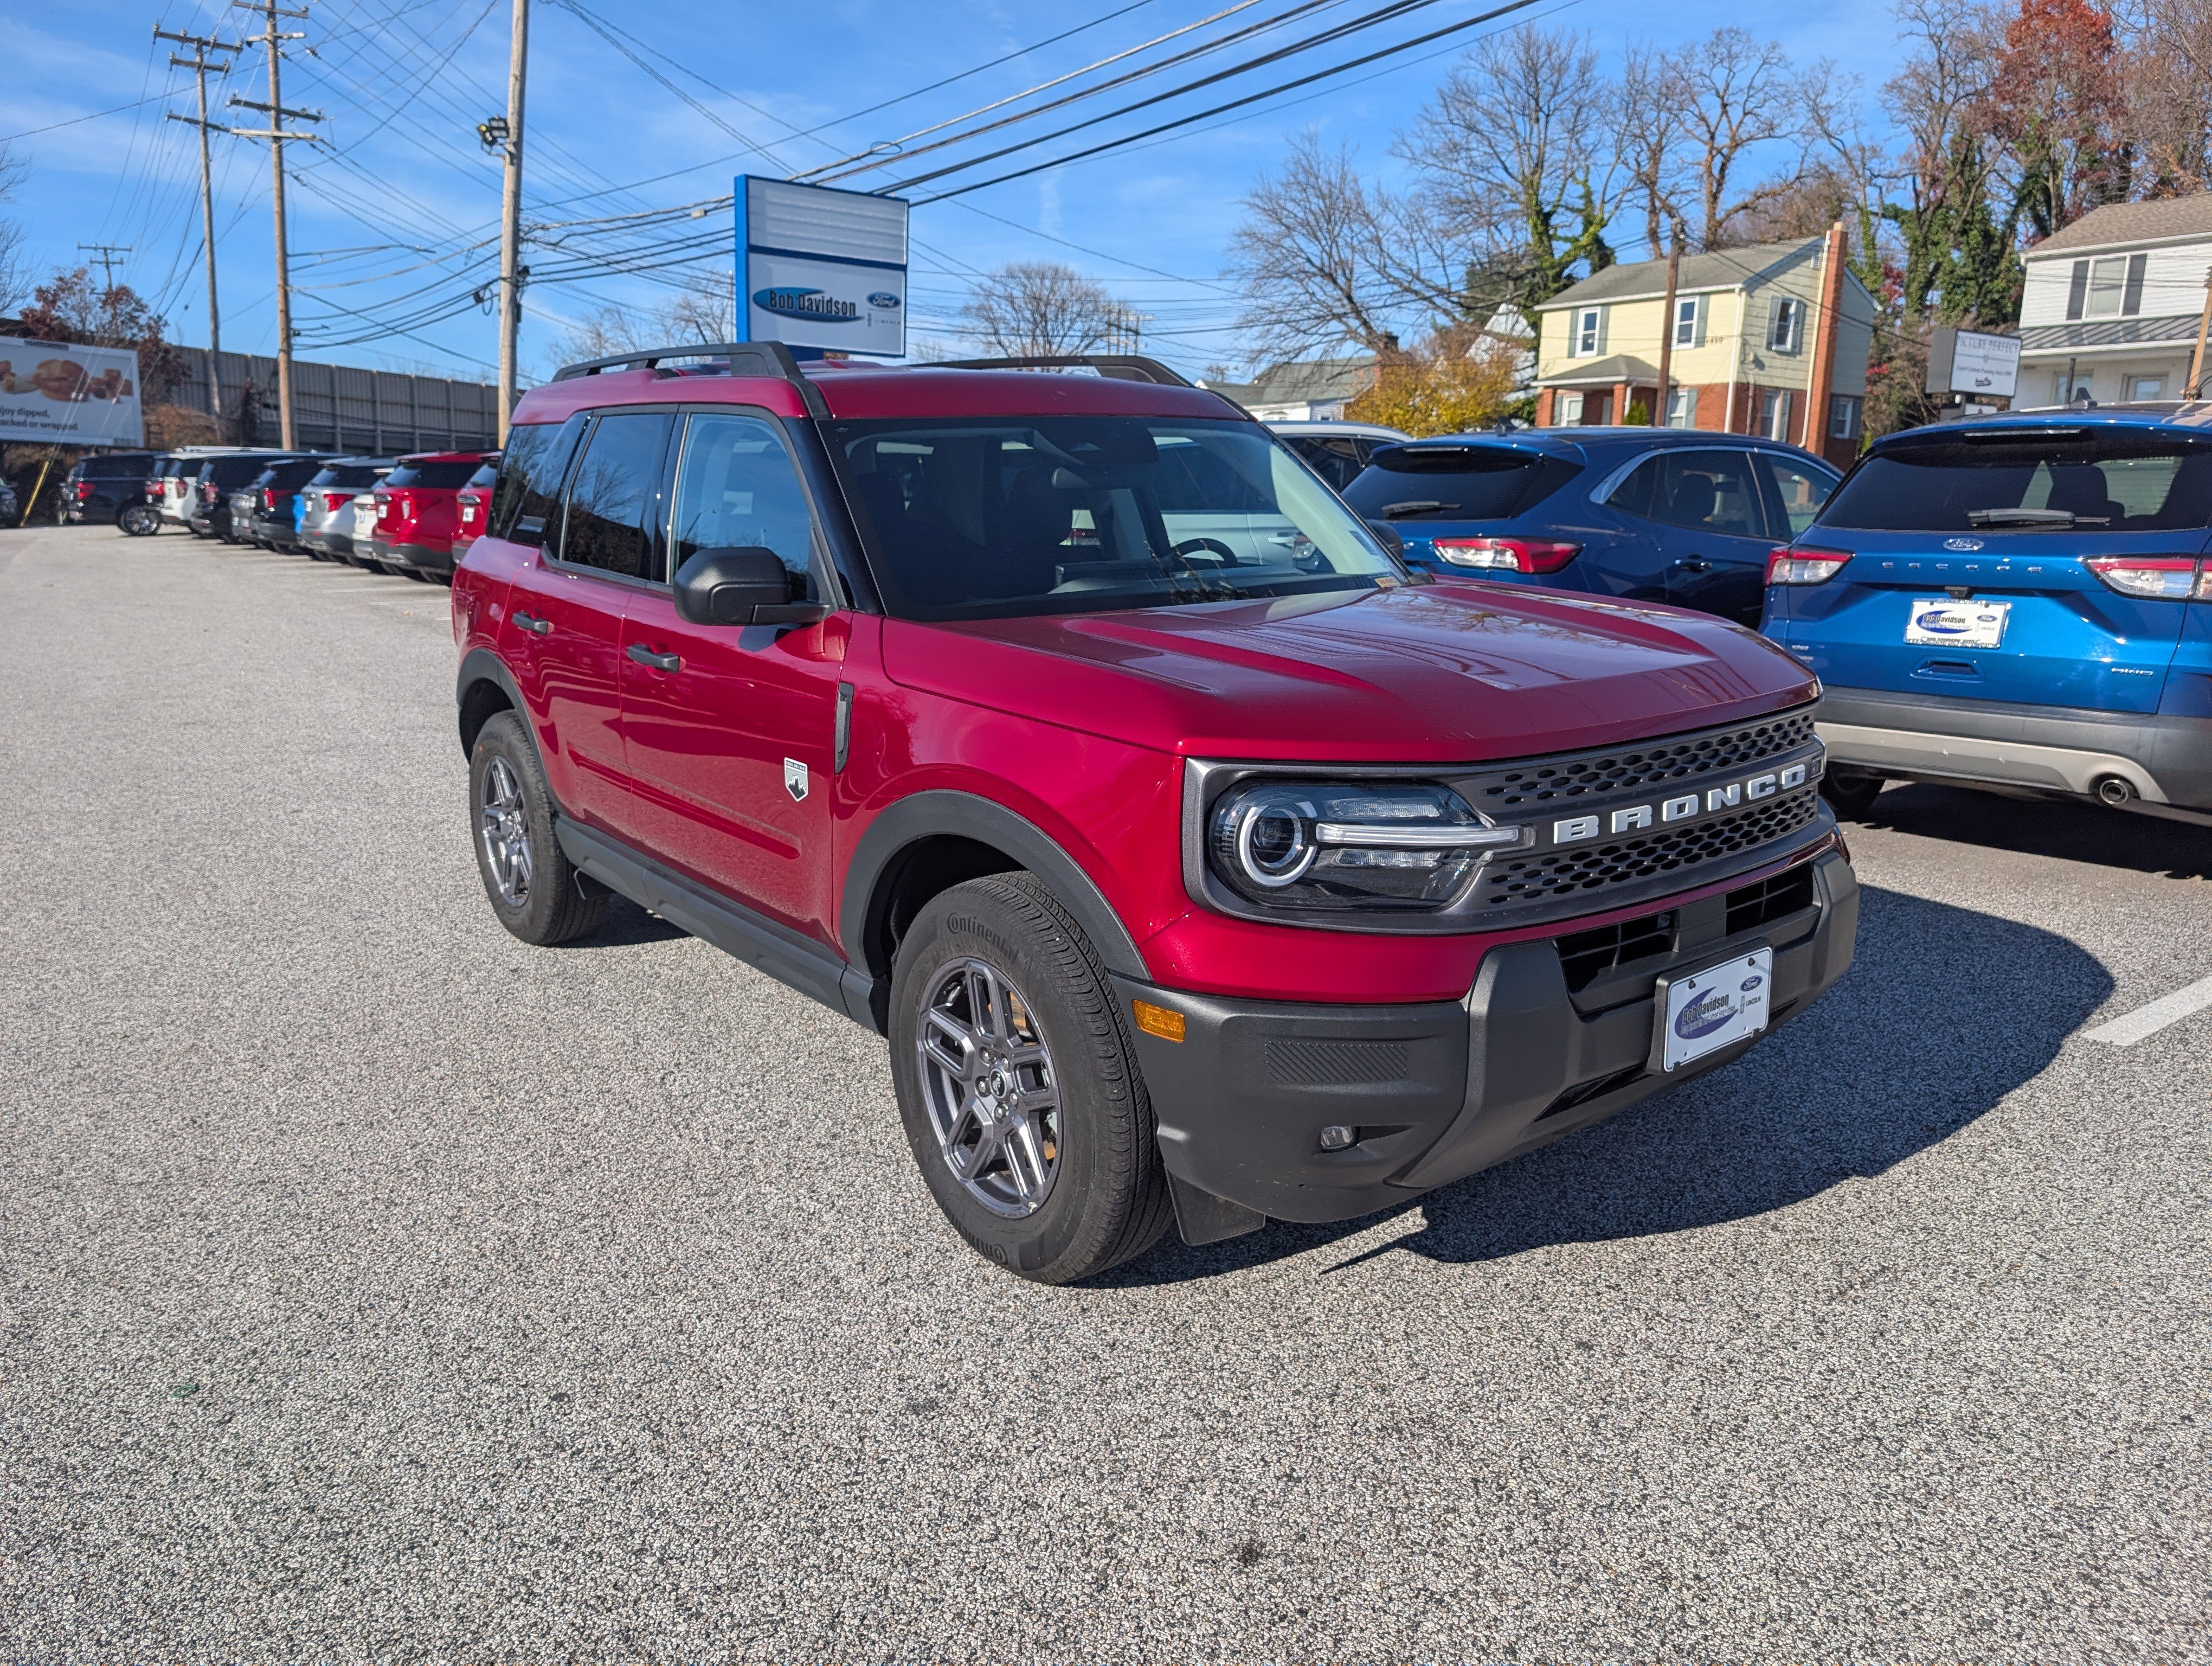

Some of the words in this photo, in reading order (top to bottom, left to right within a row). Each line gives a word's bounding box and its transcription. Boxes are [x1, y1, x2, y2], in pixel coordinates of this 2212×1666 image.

[769, 290, 794, 310] Bob
[798, 293, 857, 317] Davidson
[1956, 335, 1987, 350] PICTURE
[1988, 339, 2020, 354] PERFECT
[0, 418, 27, 427] acked
[1937, 614, 1966, 624] Davidson
[1553, 764, 1806, 844] BRONCO
[1682, 1004, 1697, 1024] Bob
[1697, 994, 1729, 1016] Davidson
[1745, 996, 1761, 1007] LINCOLN
